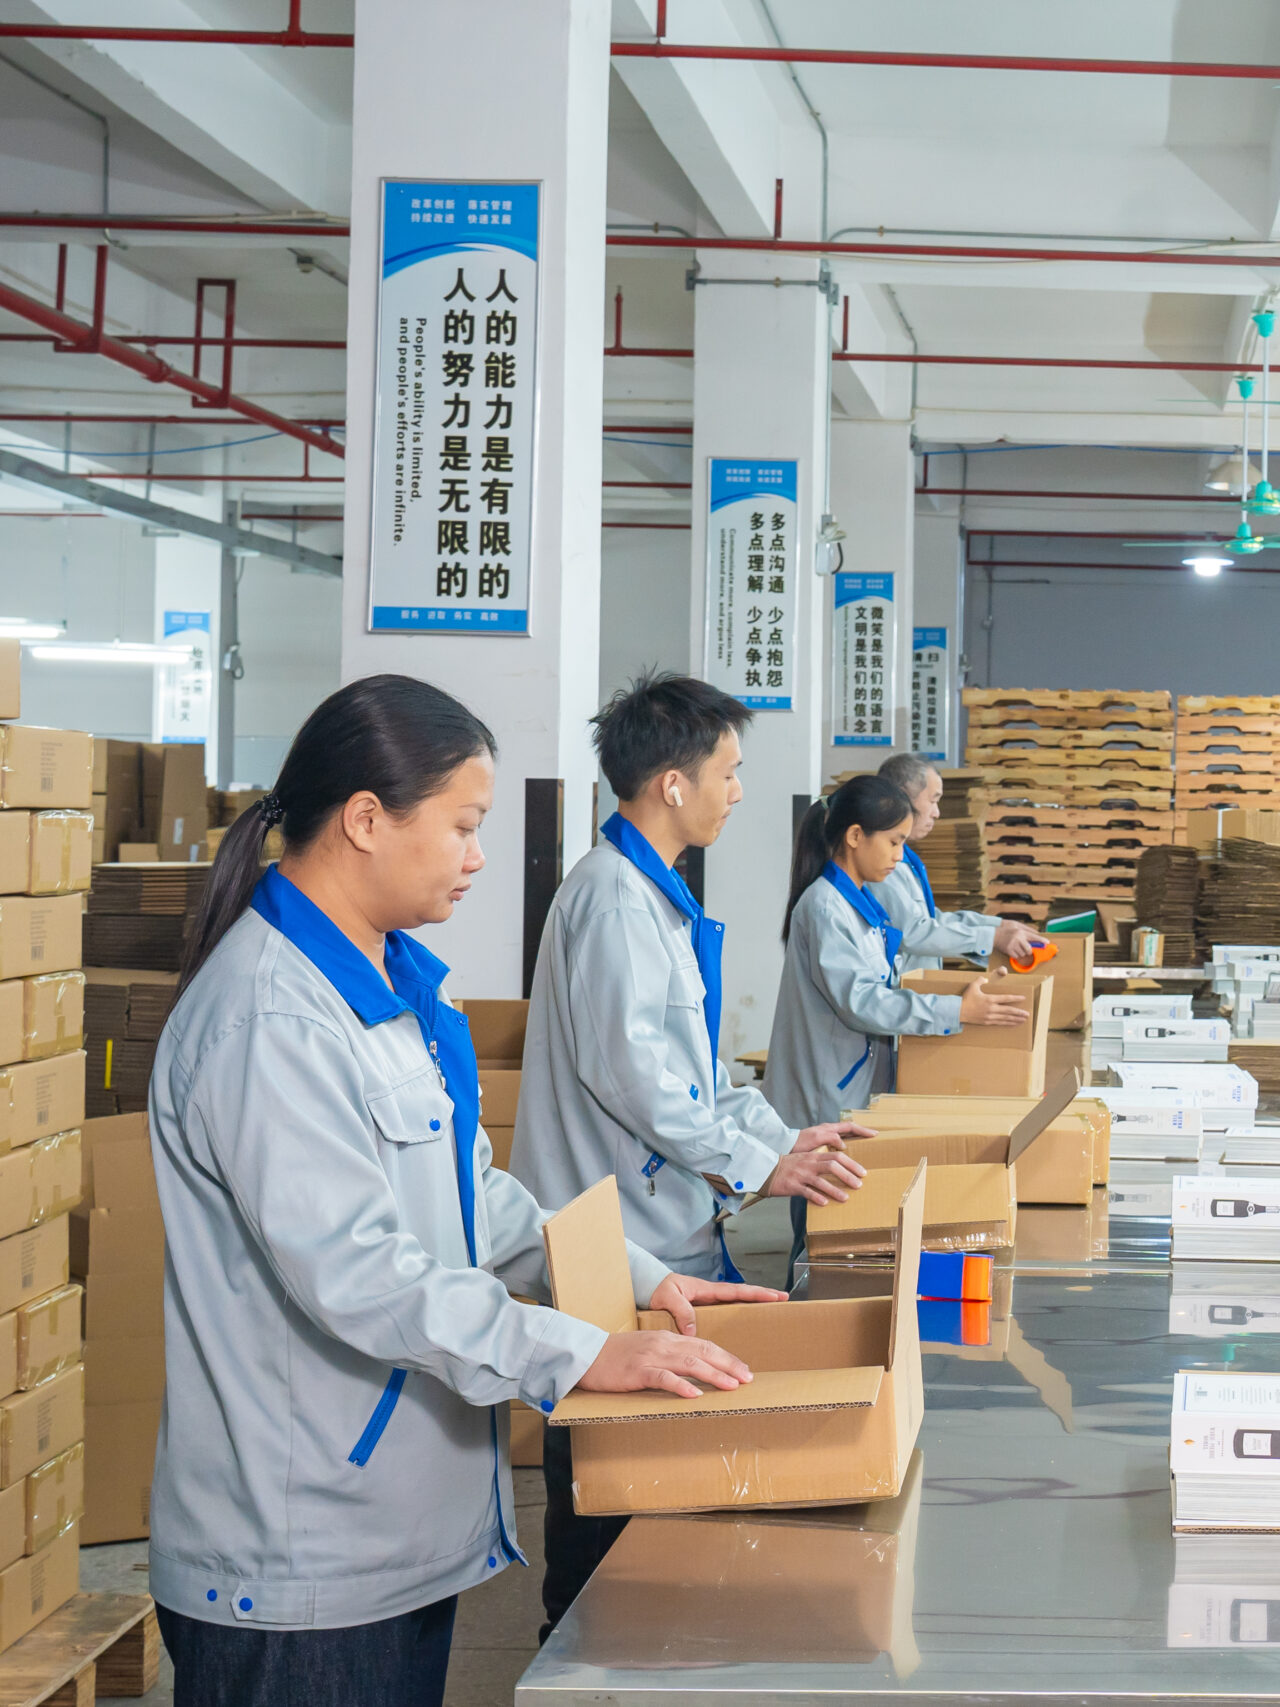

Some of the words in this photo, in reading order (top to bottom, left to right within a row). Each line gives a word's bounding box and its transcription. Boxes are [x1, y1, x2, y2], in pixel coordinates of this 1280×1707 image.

[399, 317, 410, 344] and
[413, 317, 427, 378] People's
[396, 347, 409, 408] people's
[411, 382, 425, 428] ability
[395, 463, 404, 486] are
[396, 411, 408, 460] efforts
[412, 431, 424, 443] is
[435, 268, 476, 599] 人的努力是无限的
[478, 268, 519, 600] 人的能力是有限的
[747, 512, 765, 594] 多点理解
[768, 512, 786, 594] 多点沟通
[745, 606, 763, 688] 少点争执
[766, 606, 784, 688] 少点抱怨
[854, 606, 868, 733] 文明是我们的信念
[870, 606, 884, 734] 微笑是我们的语言
